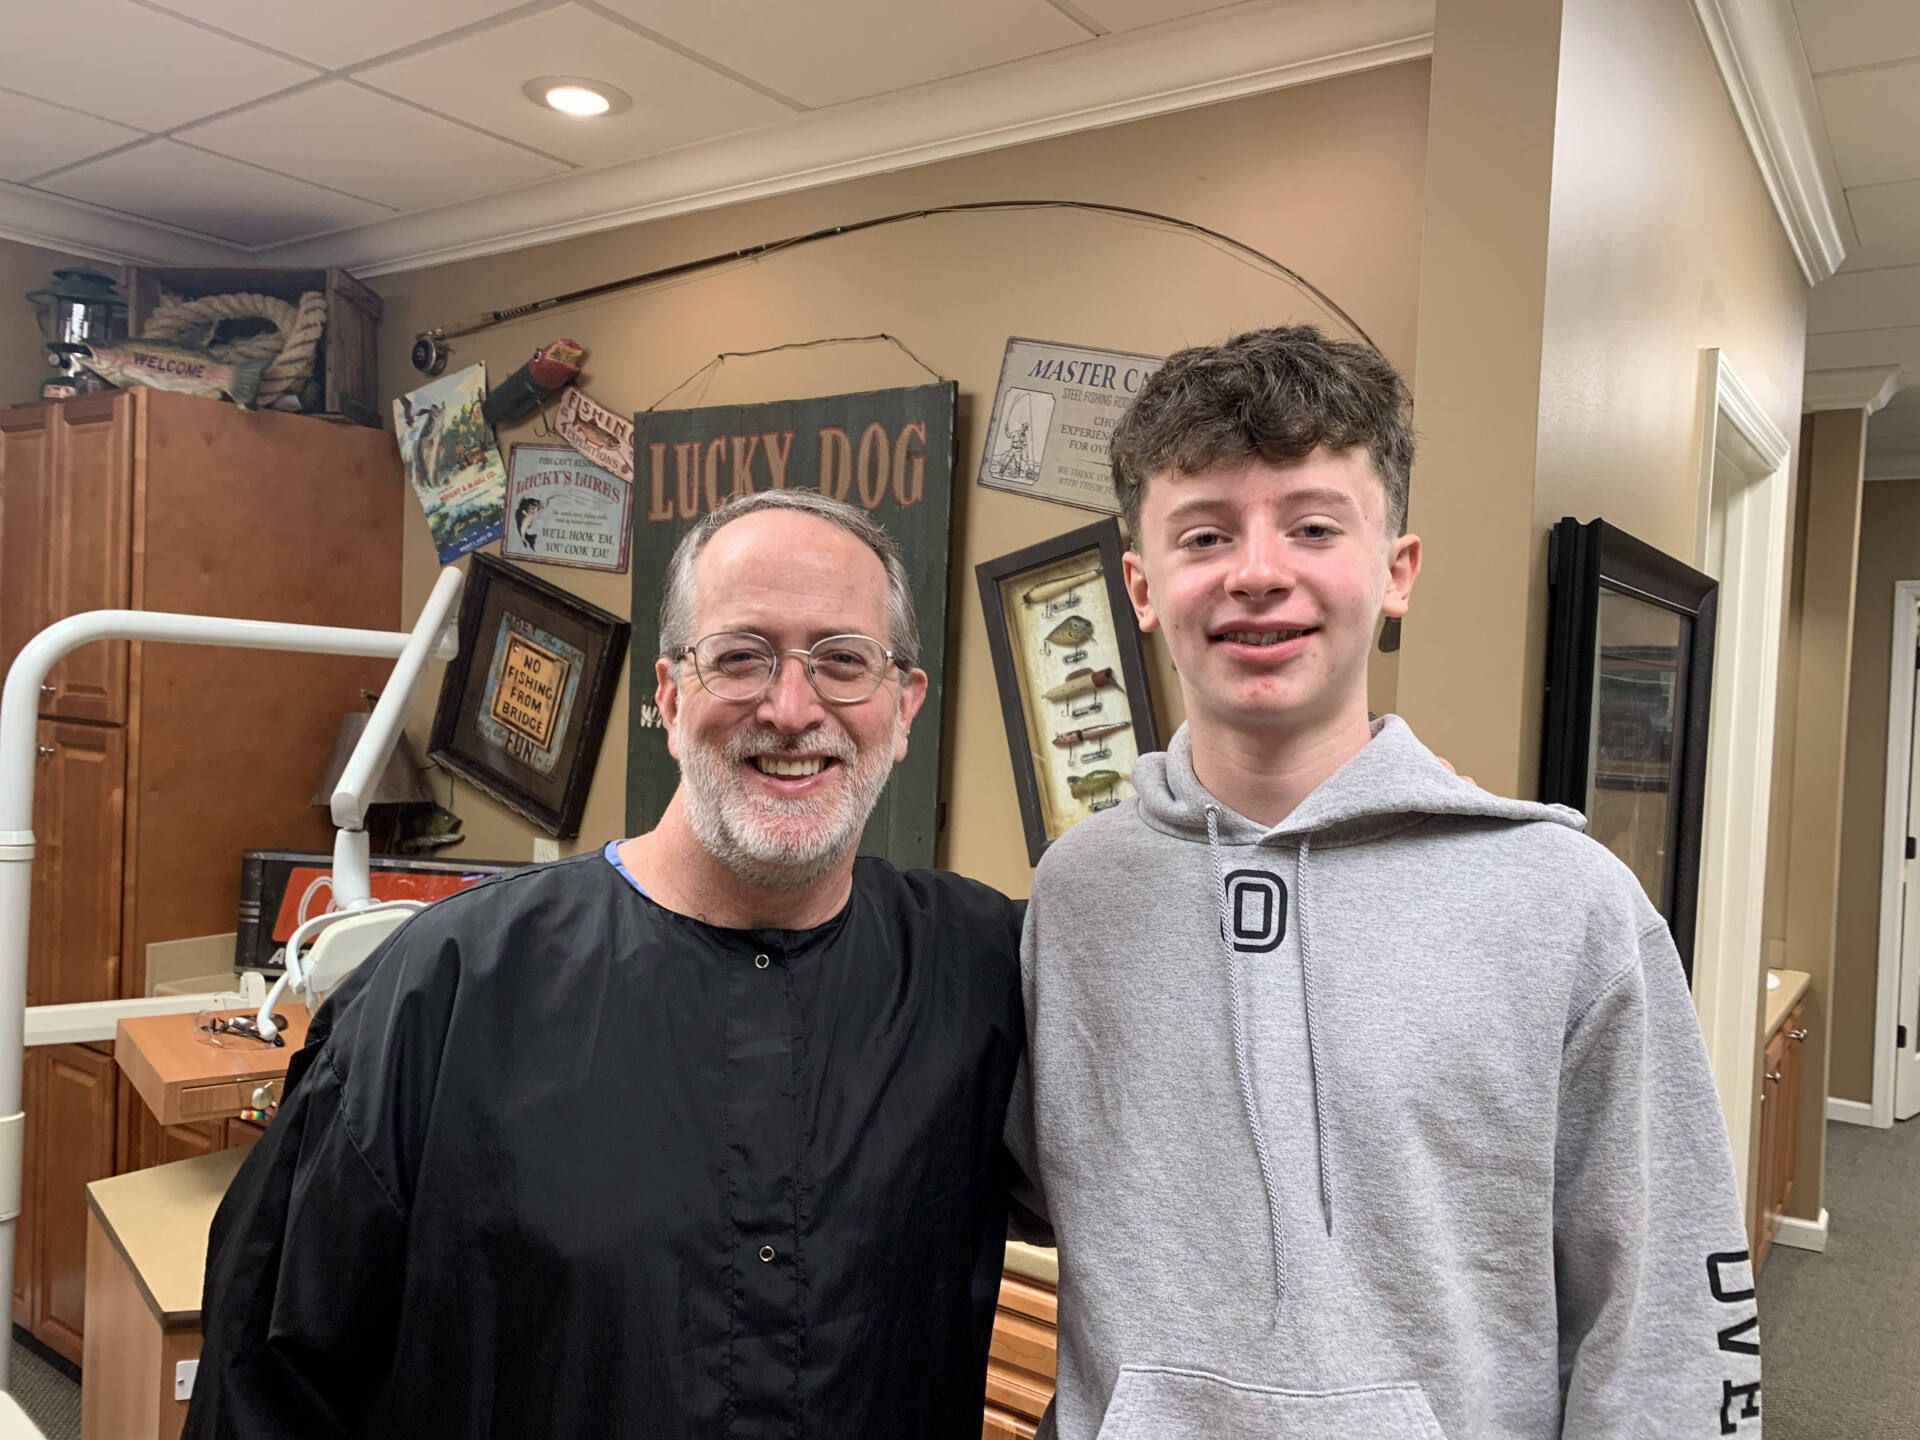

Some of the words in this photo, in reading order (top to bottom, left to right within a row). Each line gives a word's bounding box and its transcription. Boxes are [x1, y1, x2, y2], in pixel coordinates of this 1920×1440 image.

[133, 351, 205, 379] WELCOME
[1028, 359, 1117, 390] MASTER
[1069, 440, 1088, 451] FOR
[649, 430, 795, 522] LUCKY
[818, 420, 928, 509] DOG
[516, 470, 572, 496] LUCKY'S
[574, 472, 620, 505] LURES
[542, 527, 567, 540] WE'LL
[569, 530, 594, 543] HOOK
[545, 542, 563, 553] YOU
[564, 544, 588, 557] COOK
[524, 654, 541, 674] NO
[507, 665, 553, 700] FISHING
[510, 686, 542, 714] FROM
[502, 701, 544, 735] BRIDGE
[505, 730, 535, 762] FUN
